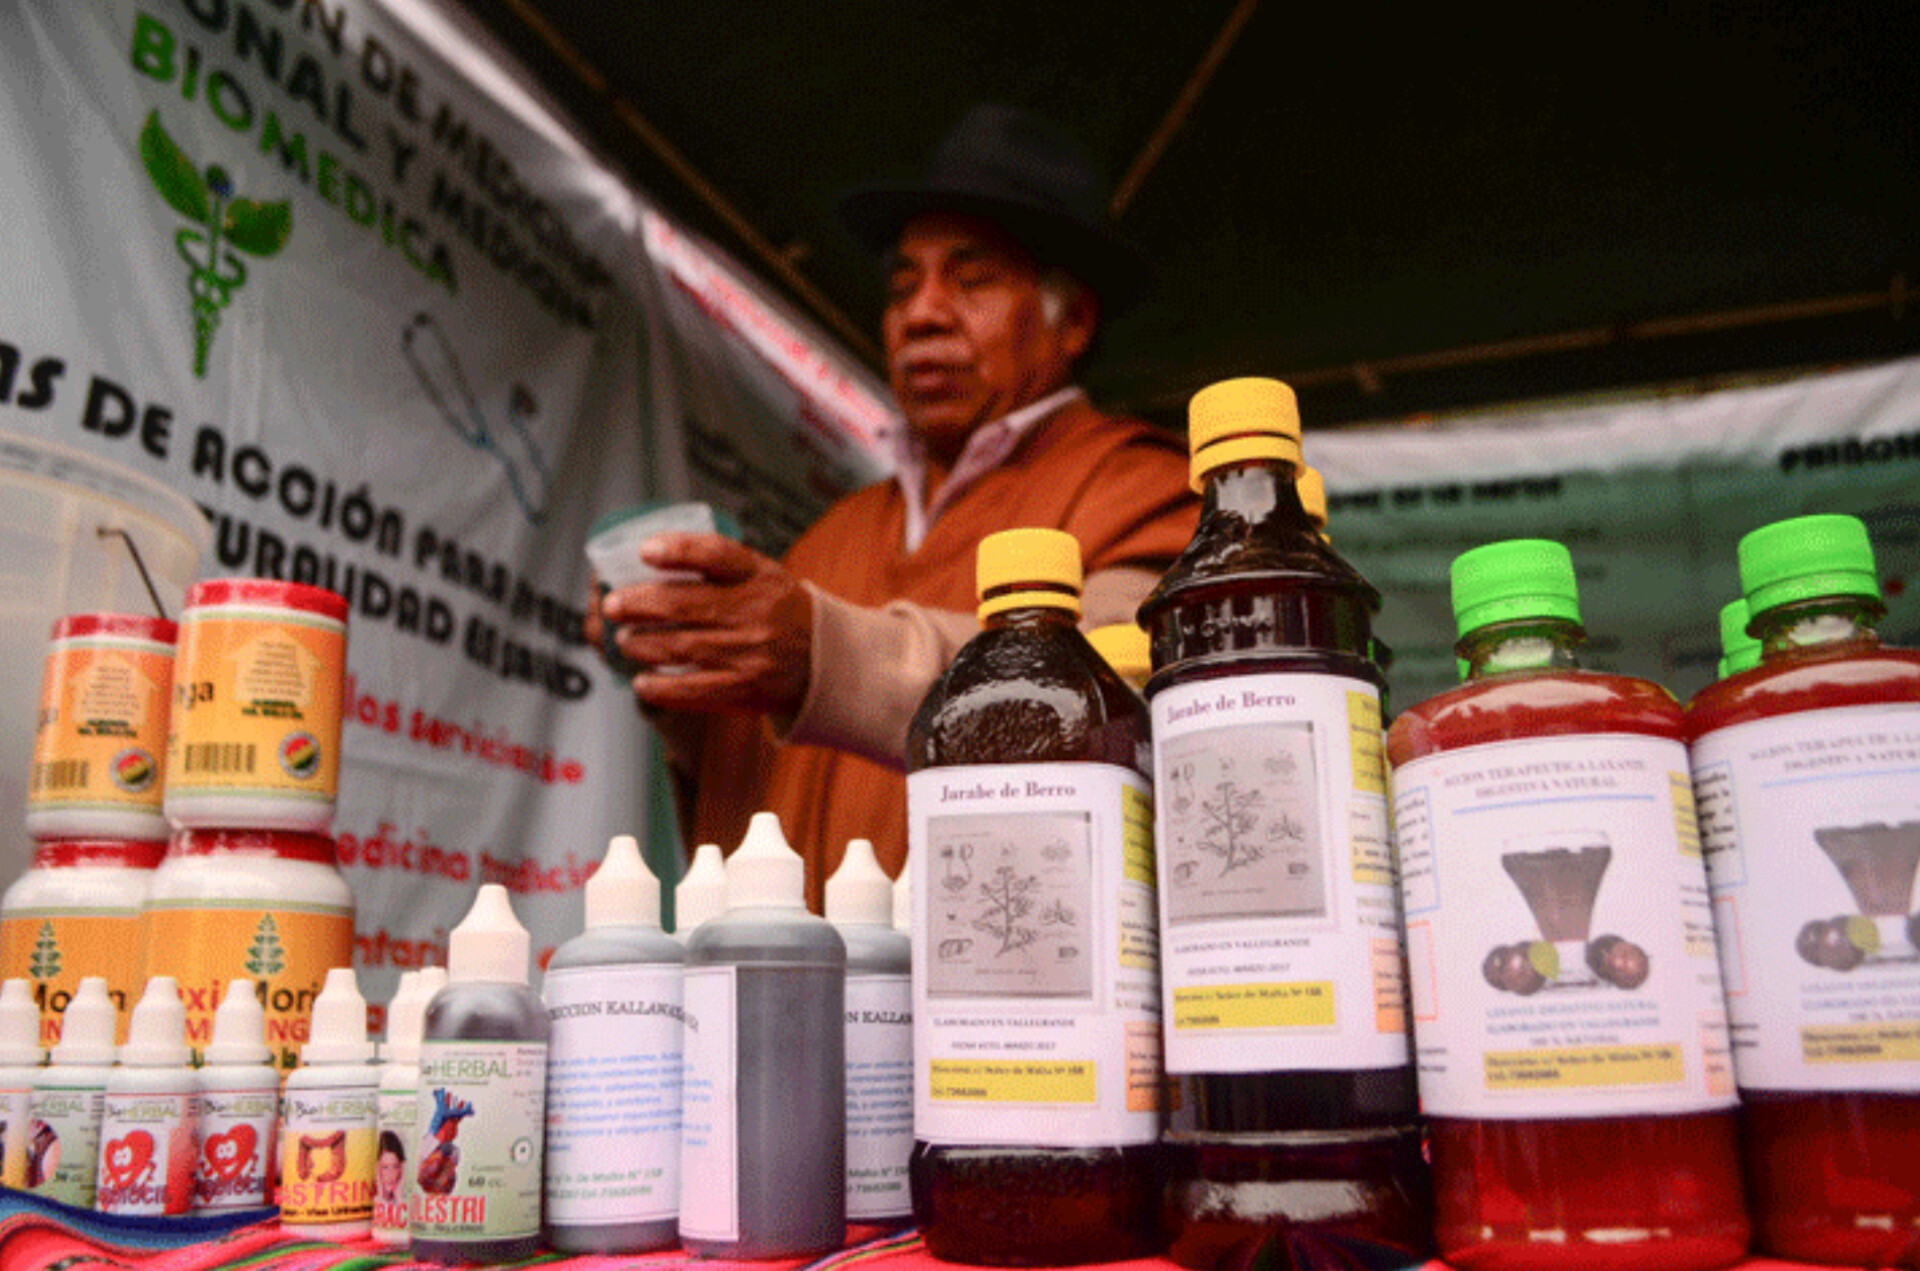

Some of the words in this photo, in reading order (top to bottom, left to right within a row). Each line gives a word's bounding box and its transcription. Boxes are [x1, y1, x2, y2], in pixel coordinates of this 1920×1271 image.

[131, 11, 457, 295] BIOMEDICA
[82, 374, 174, 460] DE
[192, 423, 403, 561] ACCIÓN
[344, 672, 400, 734] los
[1167, 699, 1212, 724] Jarabe
[1216, 695, 1236, 711] de
[1242, 691, 1296, 708] Berro
[940, 784, 995, 802] Jarabe
[1000, 781, 1020, 797] de
[1025, 781, 1076, 797] Berro
[337, 822, 470, 882] edicina
